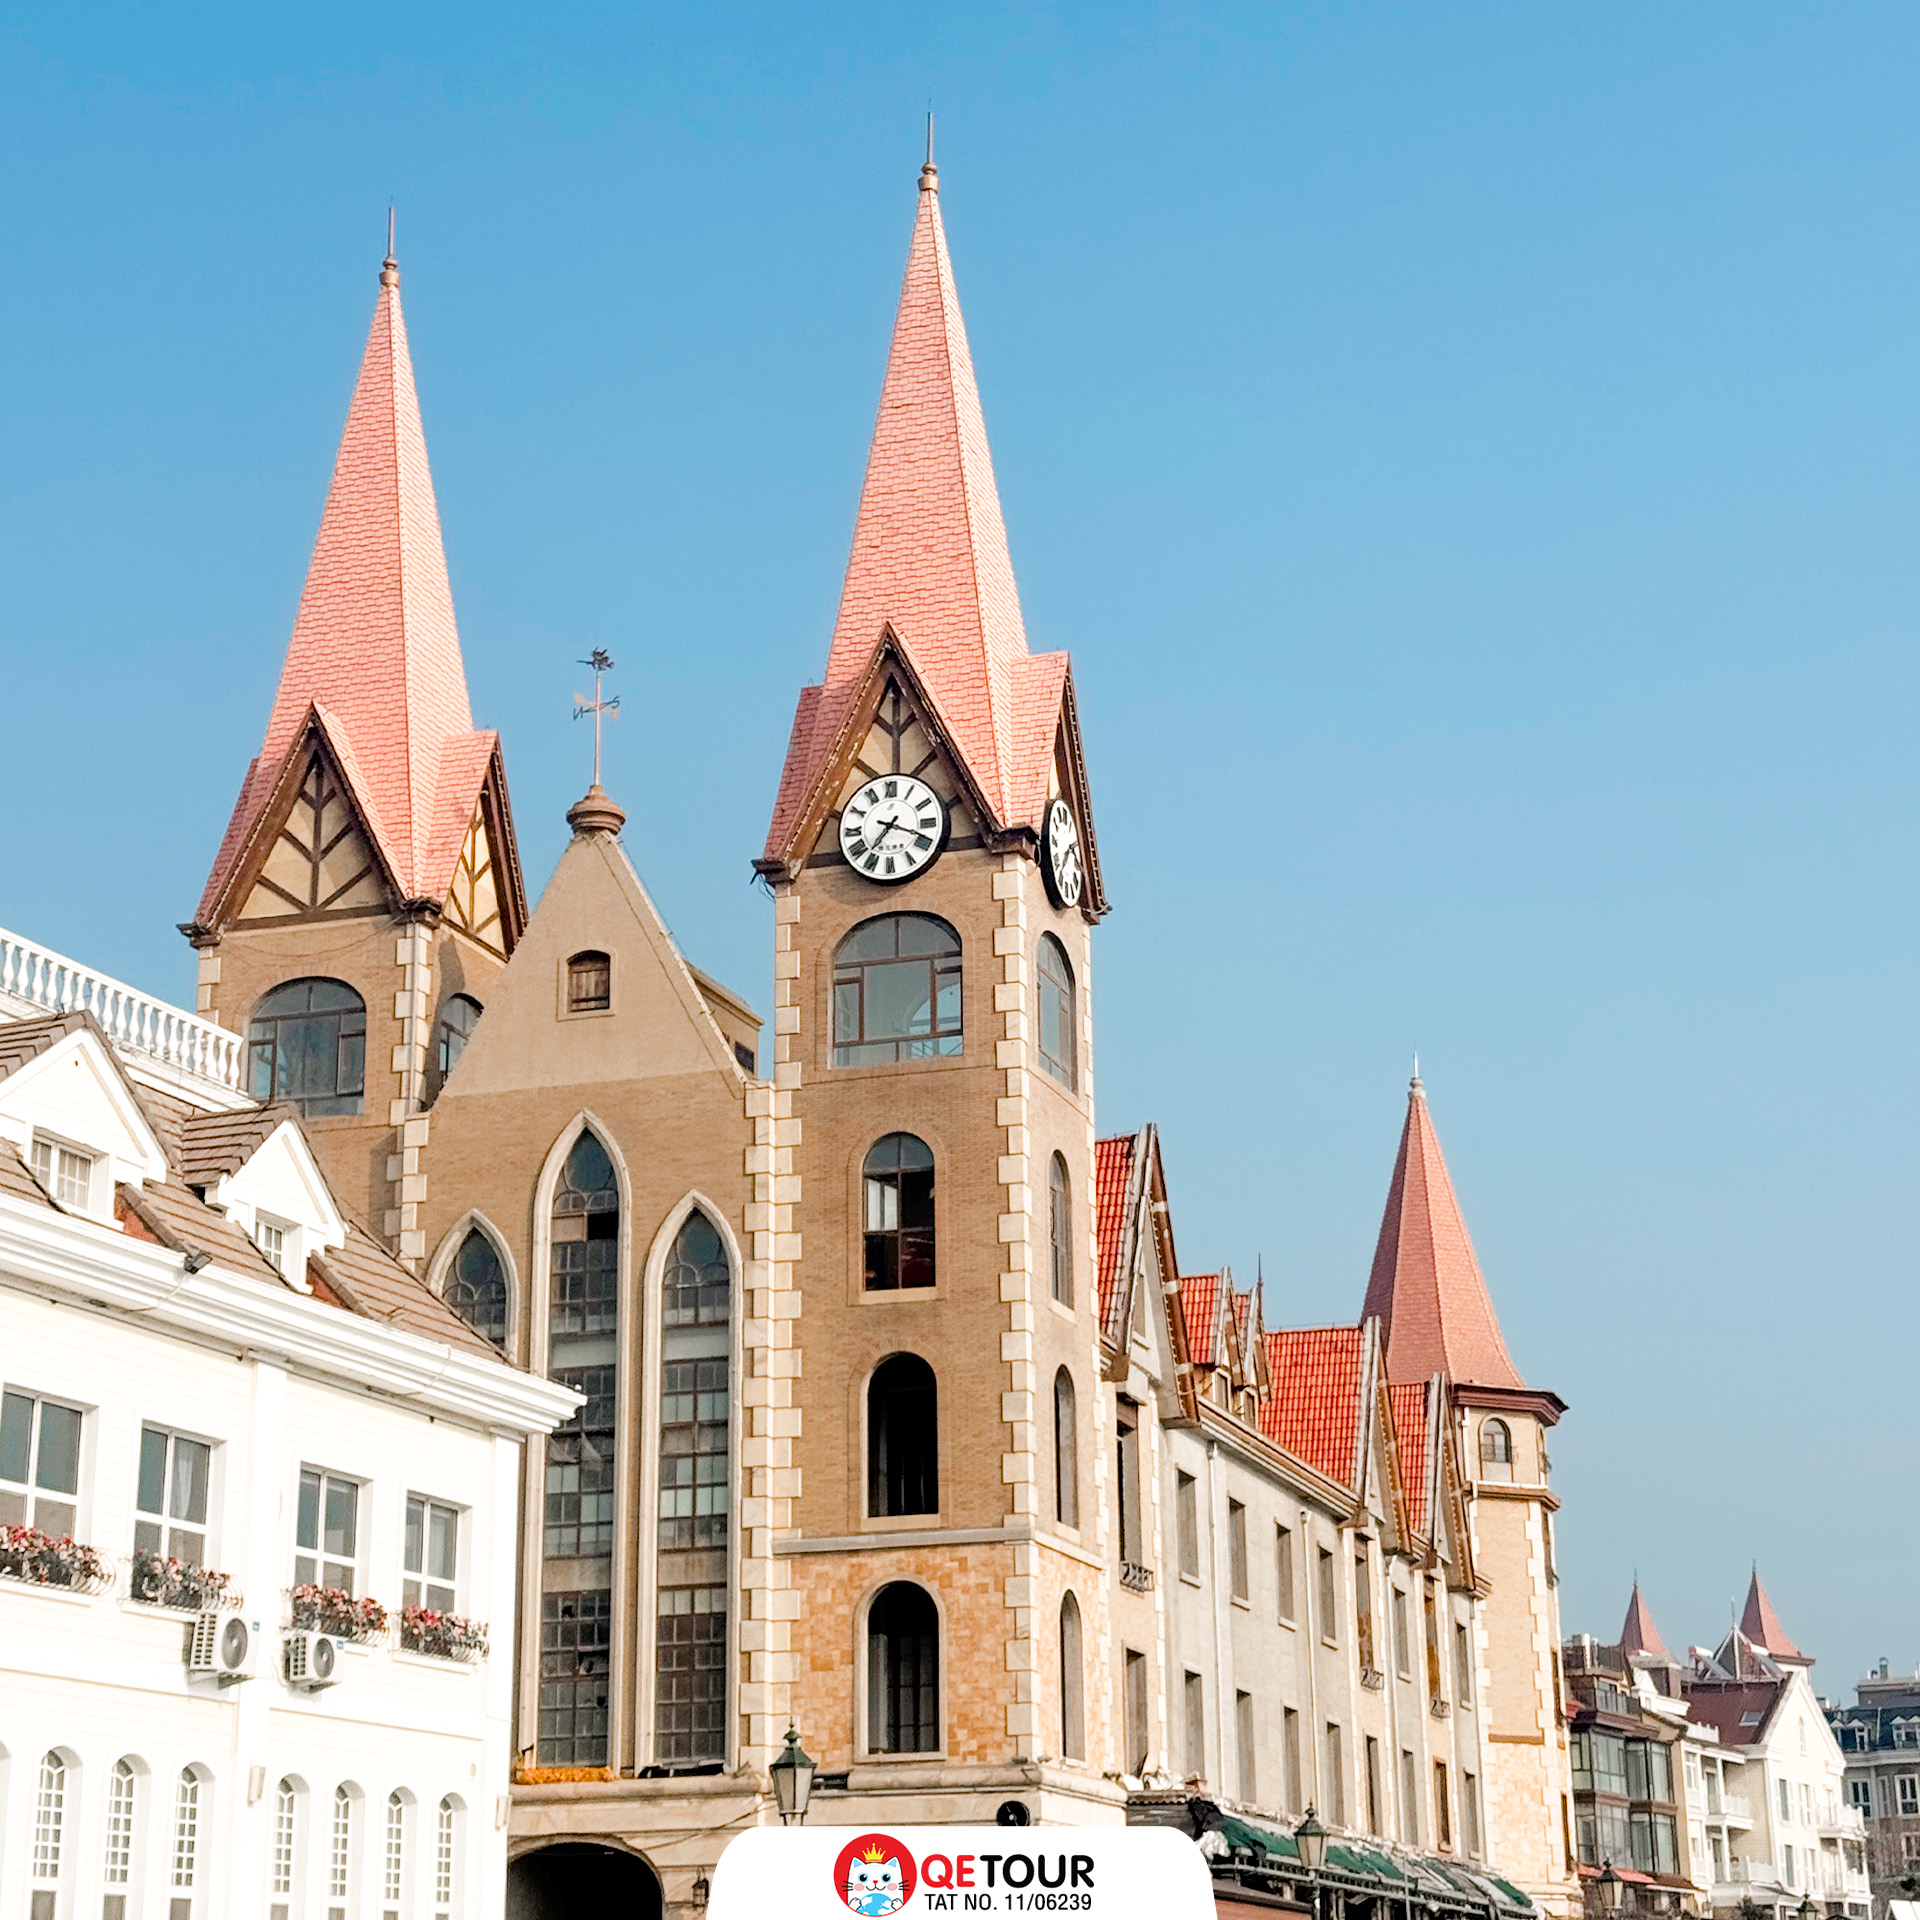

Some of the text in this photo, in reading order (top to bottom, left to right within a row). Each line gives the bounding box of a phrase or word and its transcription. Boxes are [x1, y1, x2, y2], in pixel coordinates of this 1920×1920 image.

[904, 784, 915, 800] I
[915, 797, 932, 811] II
[850, 806, 866, 818] X
[920, 817, 936, 828] III
